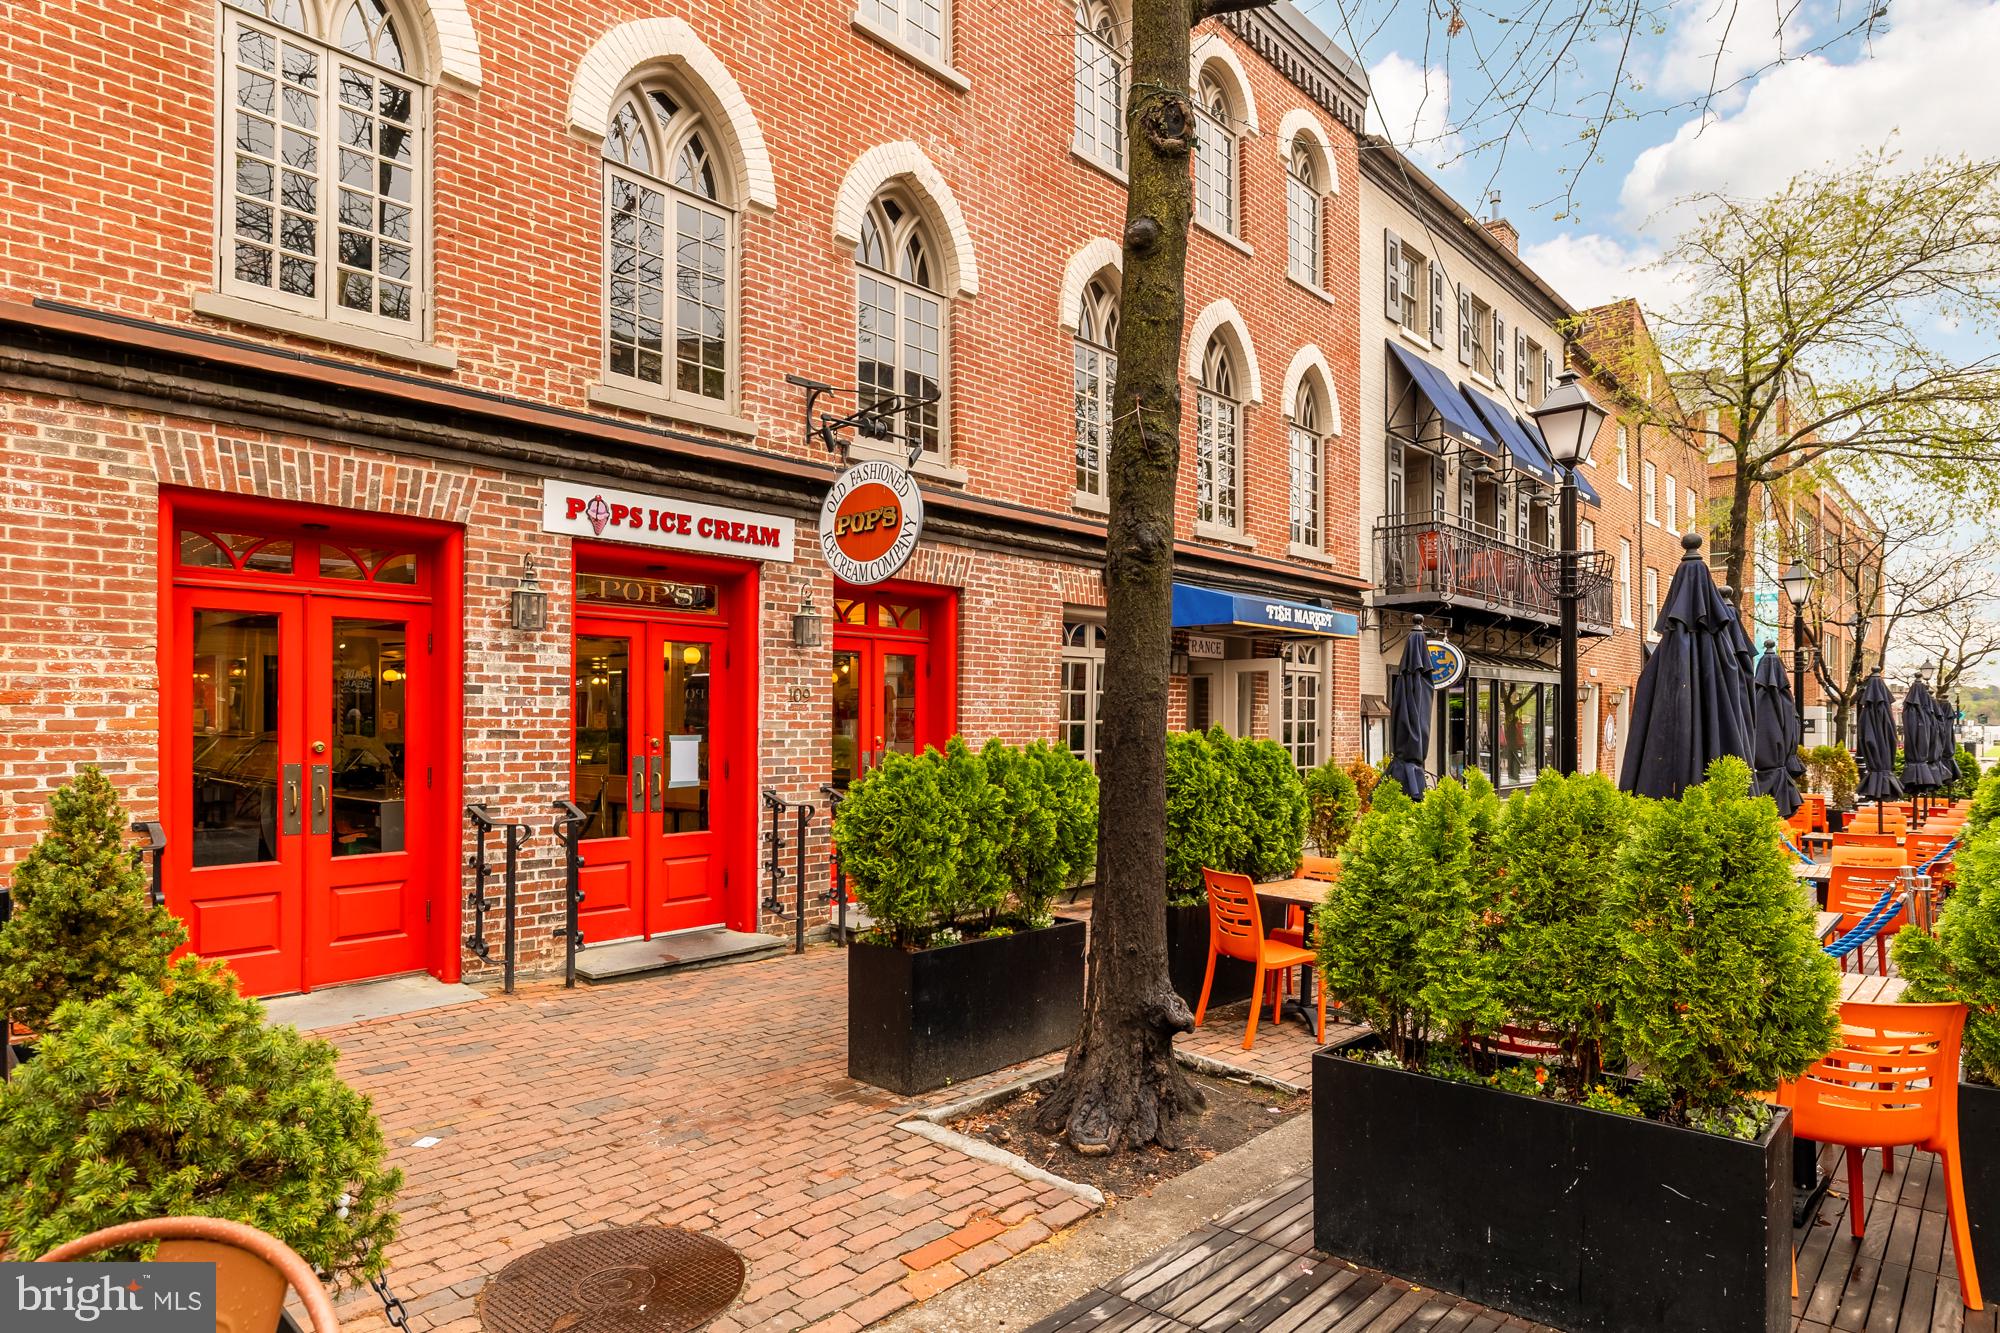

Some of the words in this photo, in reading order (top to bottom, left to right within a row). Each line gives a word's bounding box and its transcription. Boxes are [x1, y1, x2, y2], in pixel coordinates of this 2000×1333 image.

[827, 483, 846, 513] OLD
[850, 464, 909, 498] FASHIONED
[648, 509, 692, 536] ICE
[697, 517, 780, 548] CREAM
[836, 506, 897, 536] POP'S
[823, 530, 837, 559] ICE
[833, 552, 868, 581] CREAM
[870, 515, 917, 581] COMPANY
[597, 580, 694, 606] POP'S
[1266, 604, 1292, 622] FISH
[1294, 608, 1333, 631] MARKET
[1189, 639, 1222, 655] RANCE
[787, 688, 810, 703] 109
